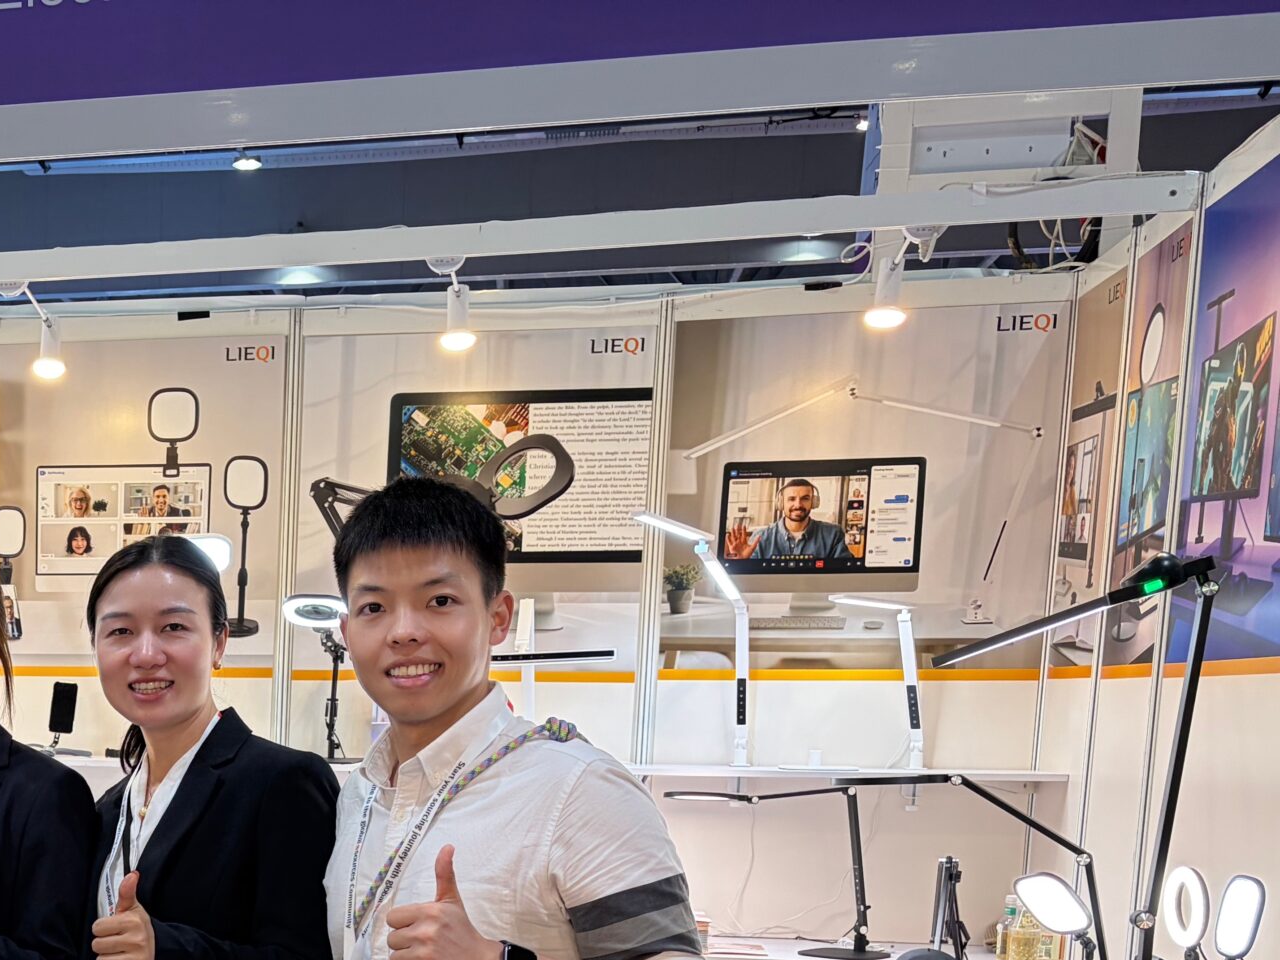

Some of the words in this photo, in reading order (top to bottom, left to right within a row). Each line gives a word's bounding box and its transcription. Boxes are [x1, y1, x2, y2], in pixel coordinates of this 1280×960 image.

[996, 312, 1059, 333] LIEQI
[225, 345, 276, 363] LIEQI
[590, 336, 645, 355] LIEQI
[448, 760, 466, 780] Start
[436, 779, 450, 797] your
[415, 797, 439, 831] sourcing
[398, 830, 419, 862] journey
[390, 862, 403, 881] with
[345, 883, 355, 929] Community
